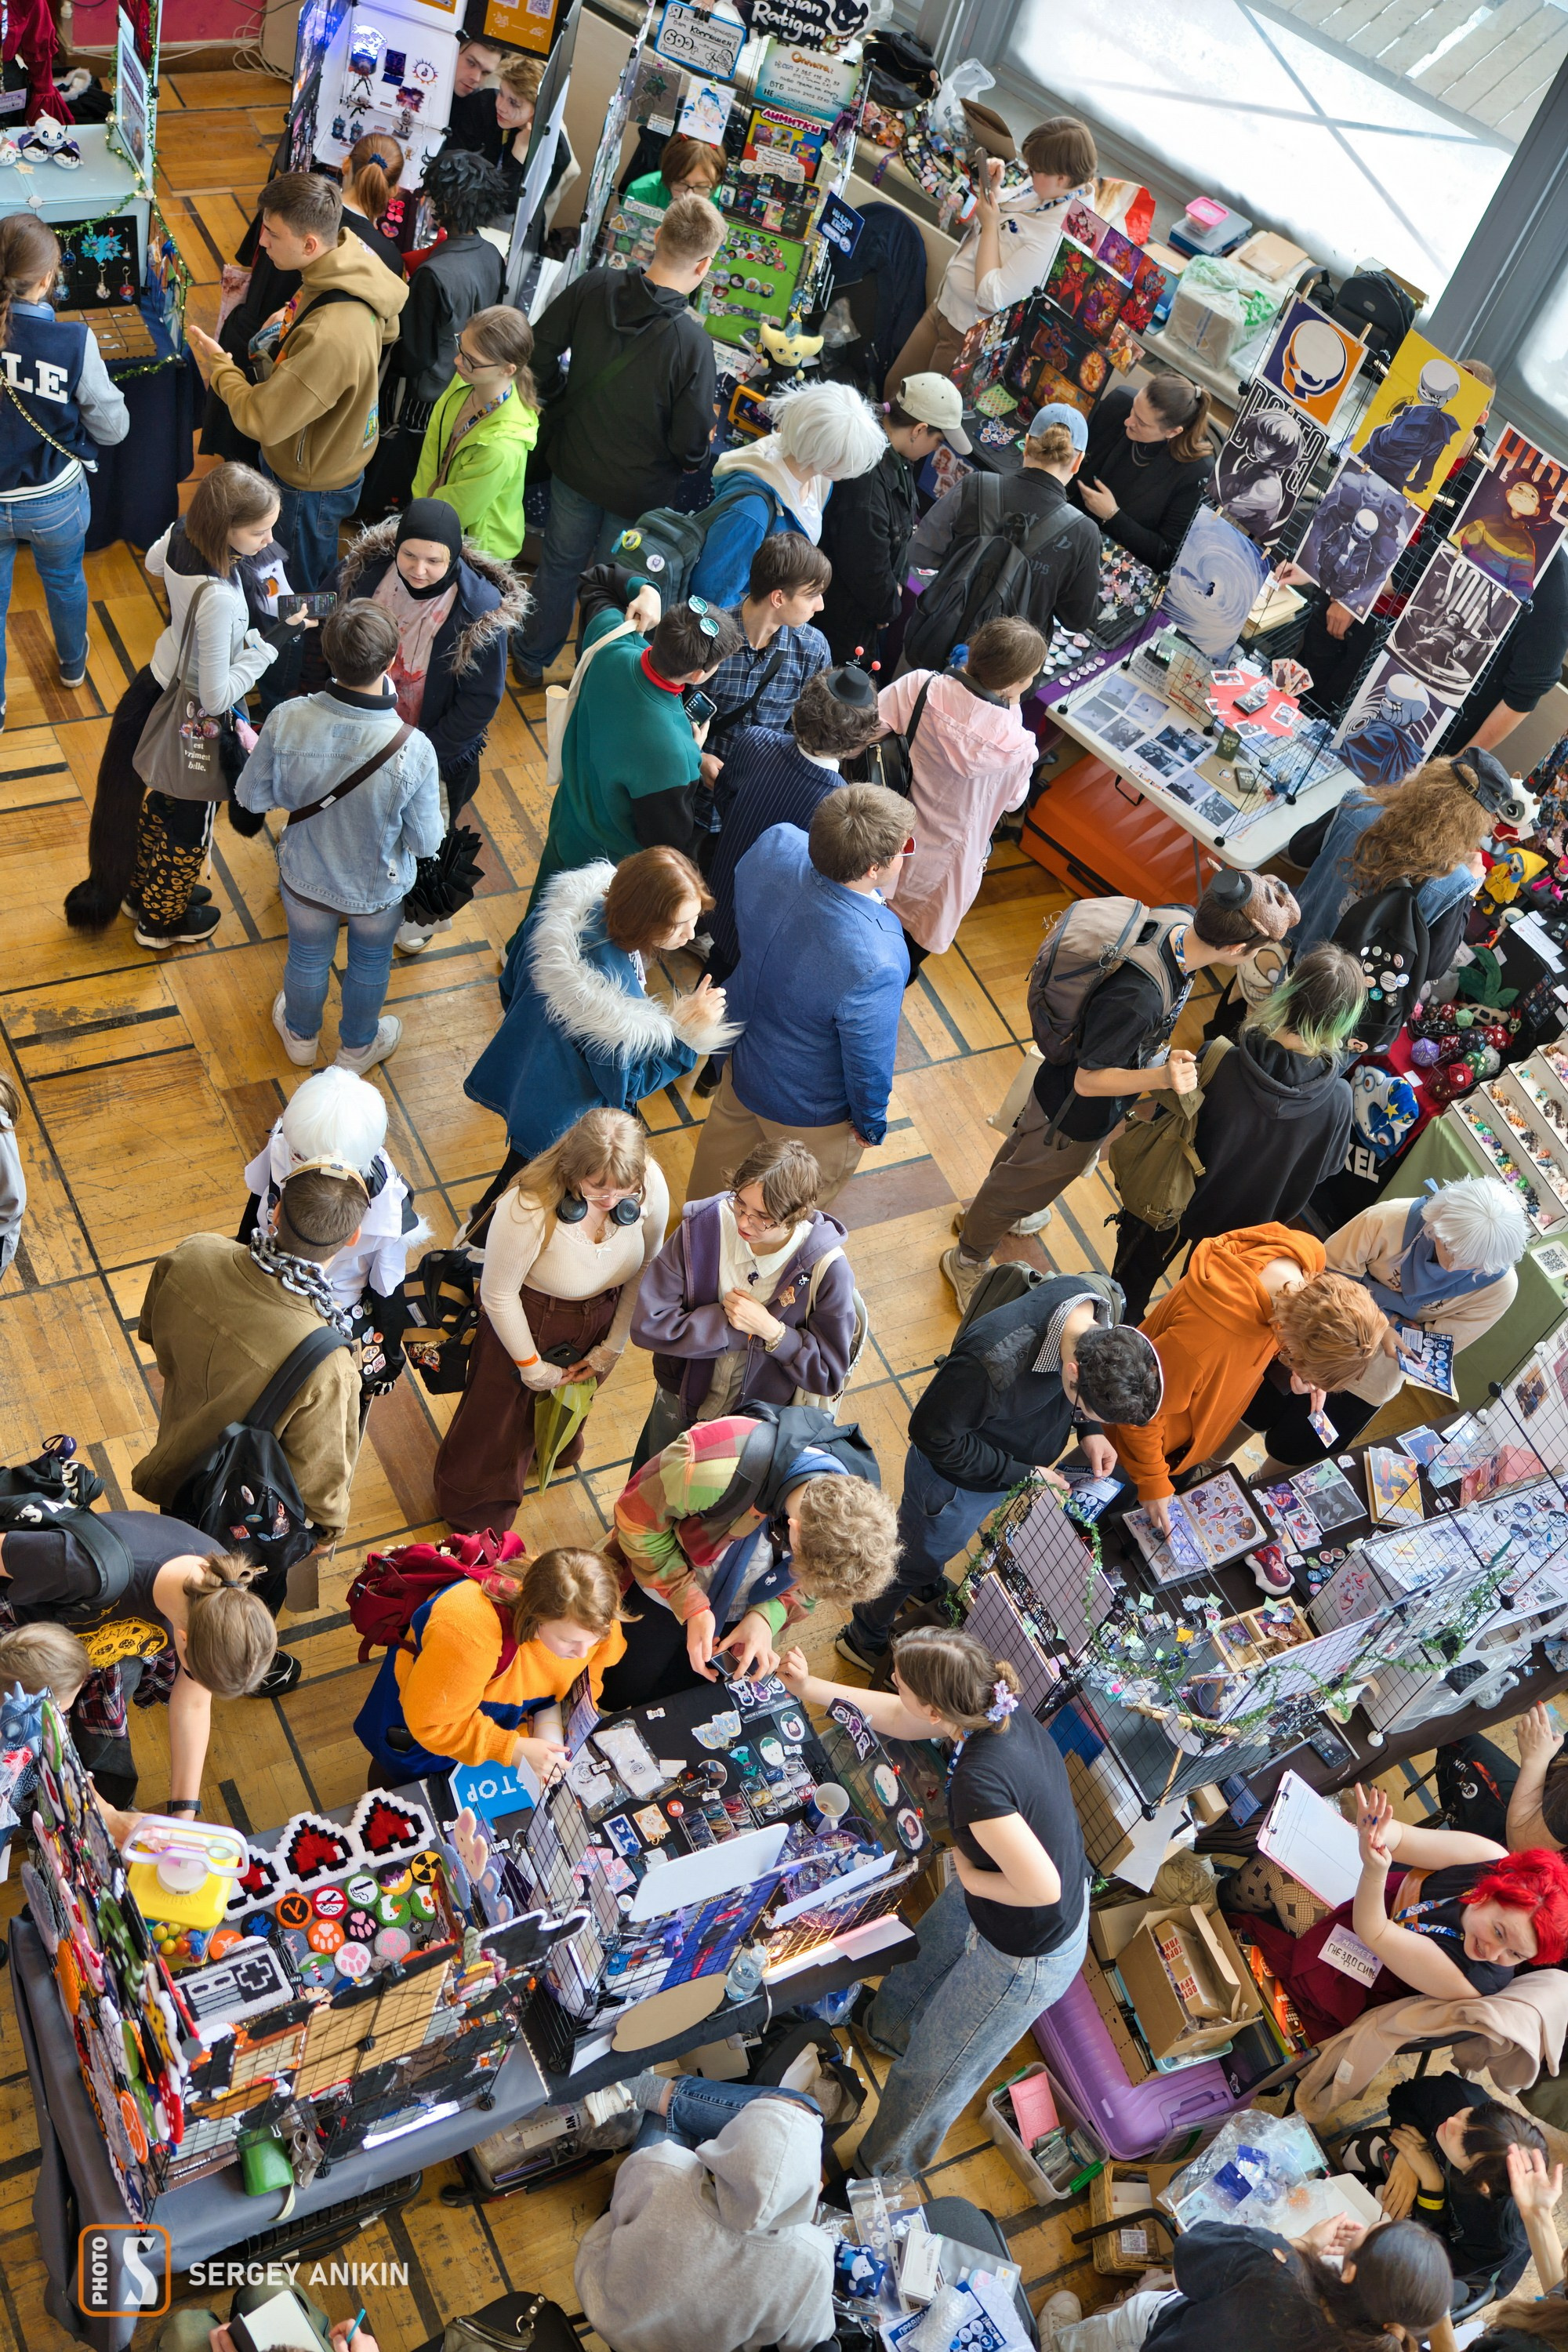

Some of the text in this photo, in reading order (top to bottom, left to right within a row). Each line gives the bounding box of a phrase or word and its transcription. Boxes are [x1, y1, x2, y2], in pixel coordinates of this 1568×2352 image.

[753, 1, 826, 42] Ratigan
[764, 89, 775, 97] НЕ
[770, 81, 785, 91] ВТБ
[762, 109, 822, 135] ЛИМИТКИ
[1341, 1938, 1371, 1959] МАРКЕТ
